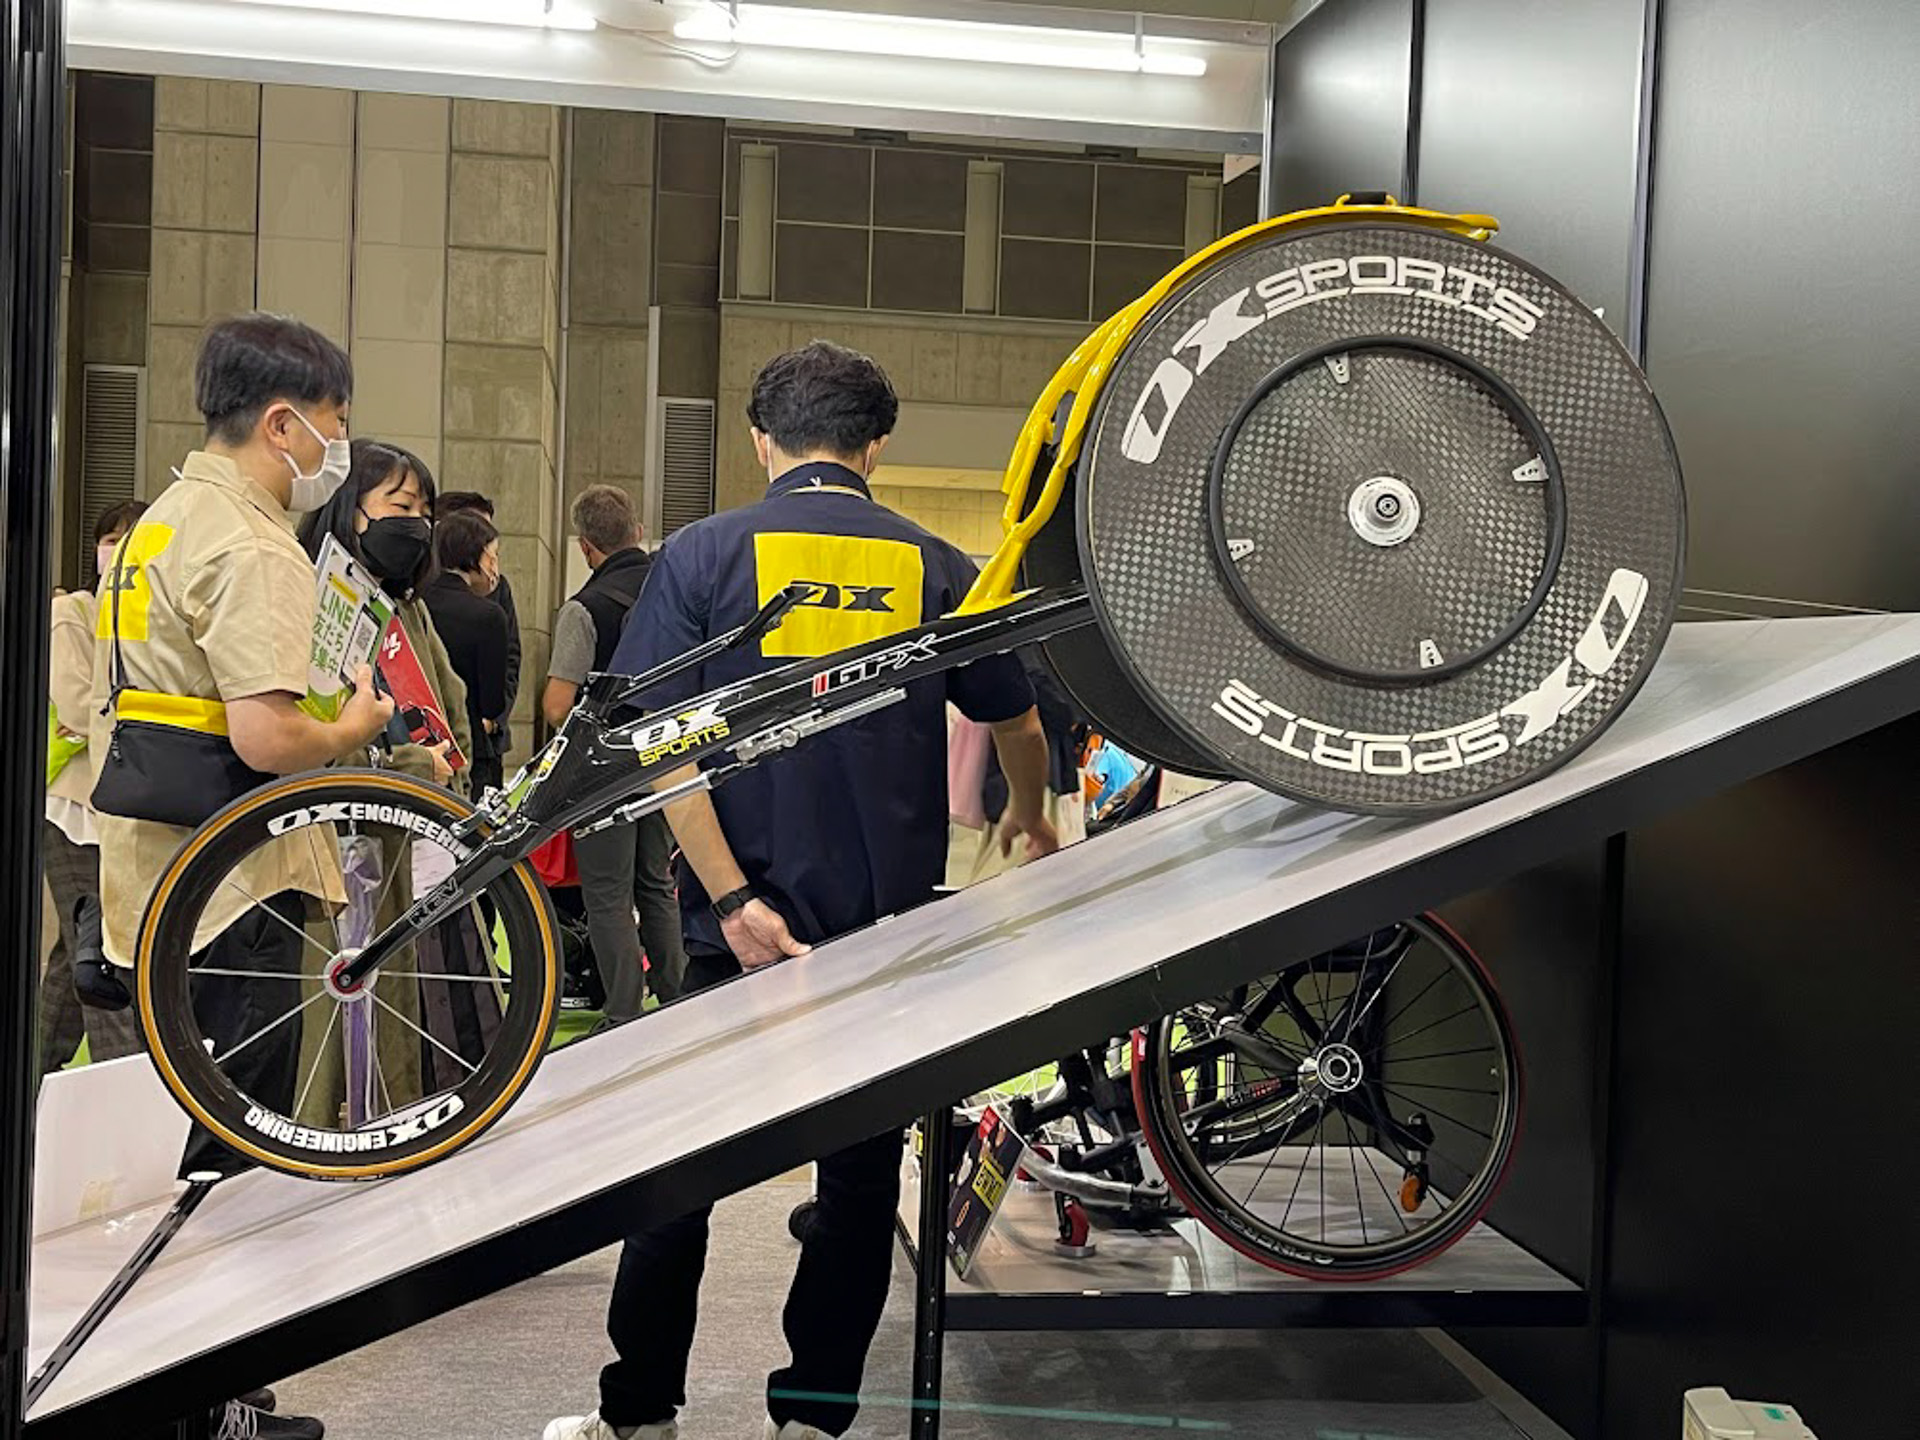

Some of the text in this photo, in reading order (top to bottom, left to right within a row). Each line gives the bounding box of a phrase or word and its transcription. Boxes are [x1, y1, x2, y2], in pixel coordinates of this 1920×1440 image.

[1121, 256, 1545, 464] OX SPORTS
[313, 613, 345, 653] 友だち
[320, 584, 355, 631] LINE
[1211, 568, 1649, 775] OX SPORTS
[638, 722, 730, 766] SPORTS
[267, 802, 473, 859] OX ENGINEERIN
[408, 877, 462, 929] REV
[243, 1094, 465, 1153] OX ENGINEERING
